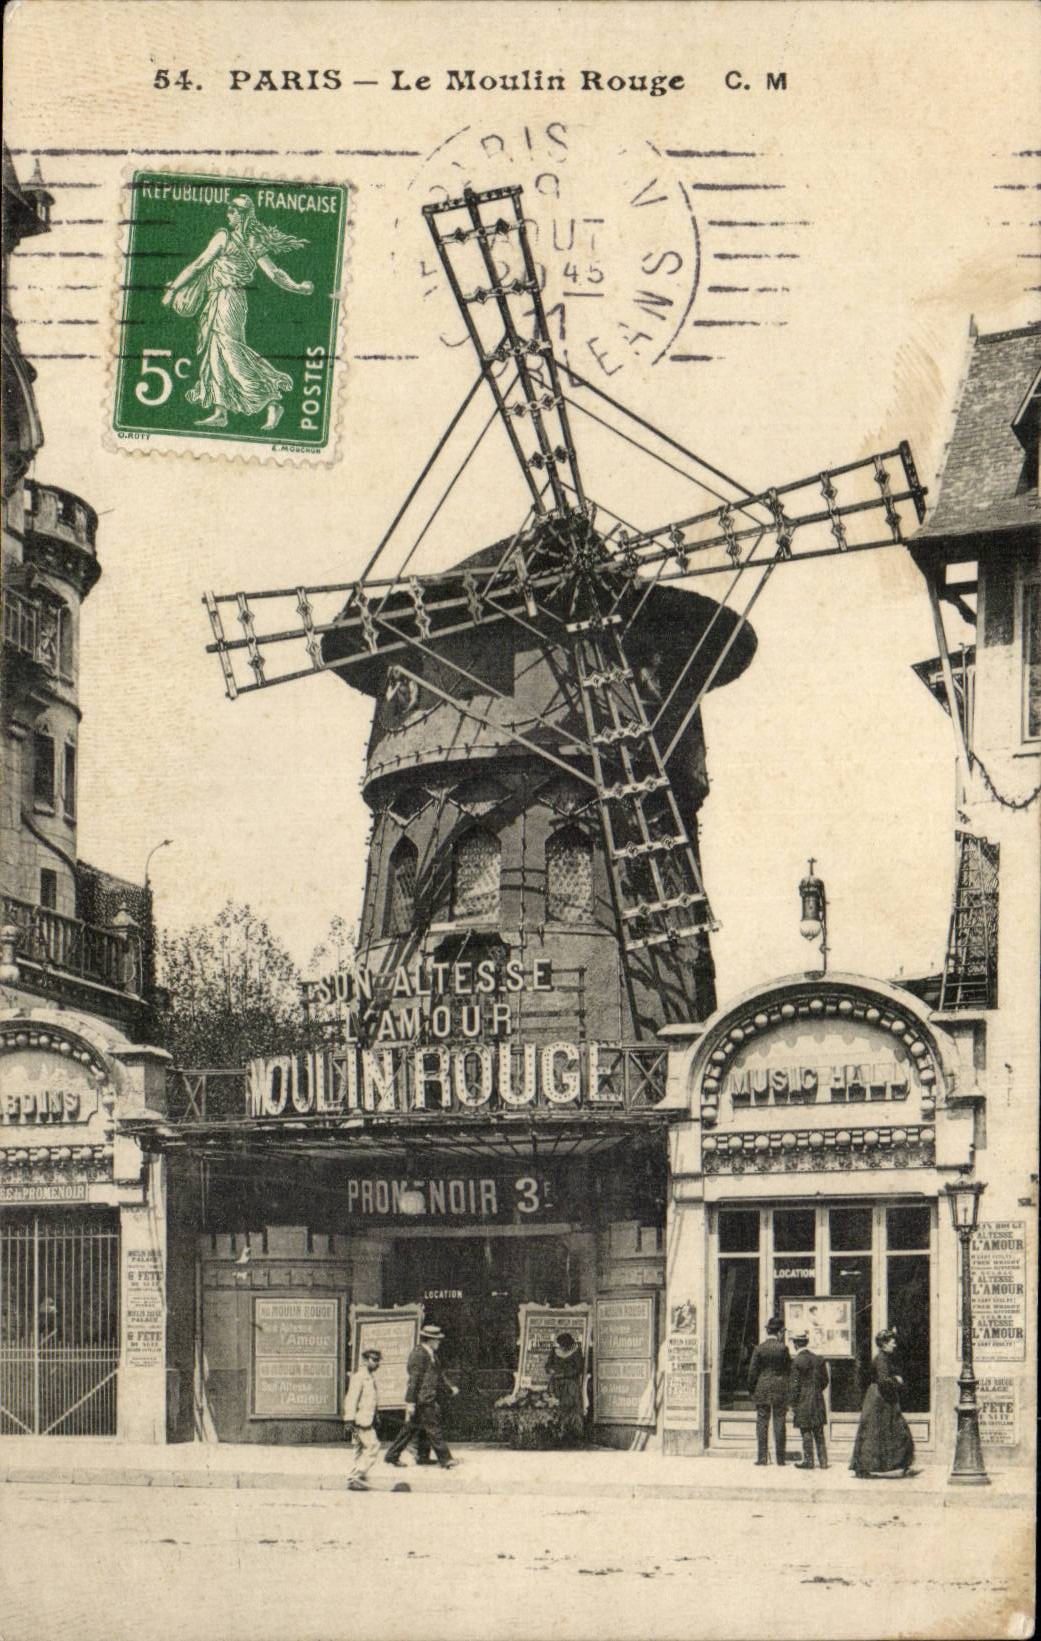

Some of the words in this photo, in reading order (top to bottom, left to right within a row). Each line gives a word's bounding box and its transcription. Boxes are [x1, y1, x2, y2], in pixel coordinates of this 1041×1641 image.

[257, 190, 337, 214] FRANÇAISE
[300, 345, 326, 431] POSTES
[392, 957, 553, 998] ALTESSE
[248, 1047, 397, 1118] MOULIN
[413, 1040, 624, 1109] ROUGE
[729, 1068, 818, 1104] MUSIC
[972, 1239, 1024, 1251] L'AMOUR
[773, 1268, 816, 1279] LOCATION
[424, 1289, 464, 1300] LOCATION
[972, 1283, 1024, 1295] L'AMOUR
[971, 1327, 1024, 1339] L'AMOUR
